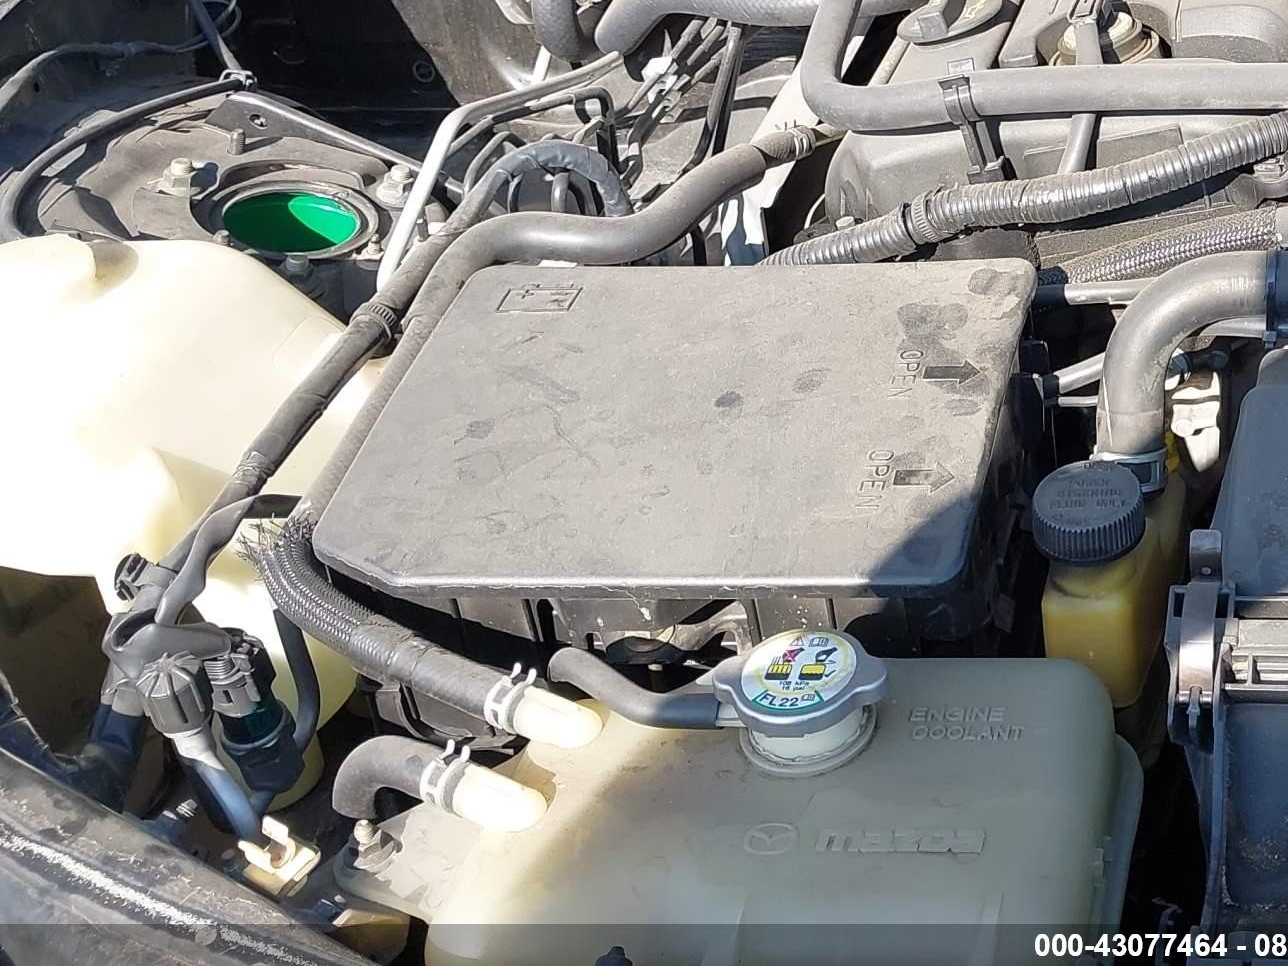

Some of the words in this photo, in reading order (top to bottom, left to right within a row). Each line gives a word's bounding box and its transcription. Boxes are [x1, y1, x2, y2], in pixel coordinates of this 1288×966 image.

[887, 349, 925, 400] OPEN
[855, 449, 895, 509] OPEN
[761, 693, 799, 707] FL22
[908, 706, 1007, 722] ENGINE
[911, 724, 1025, 741] COOLANT
[815, 828, 986, 854] mazda
